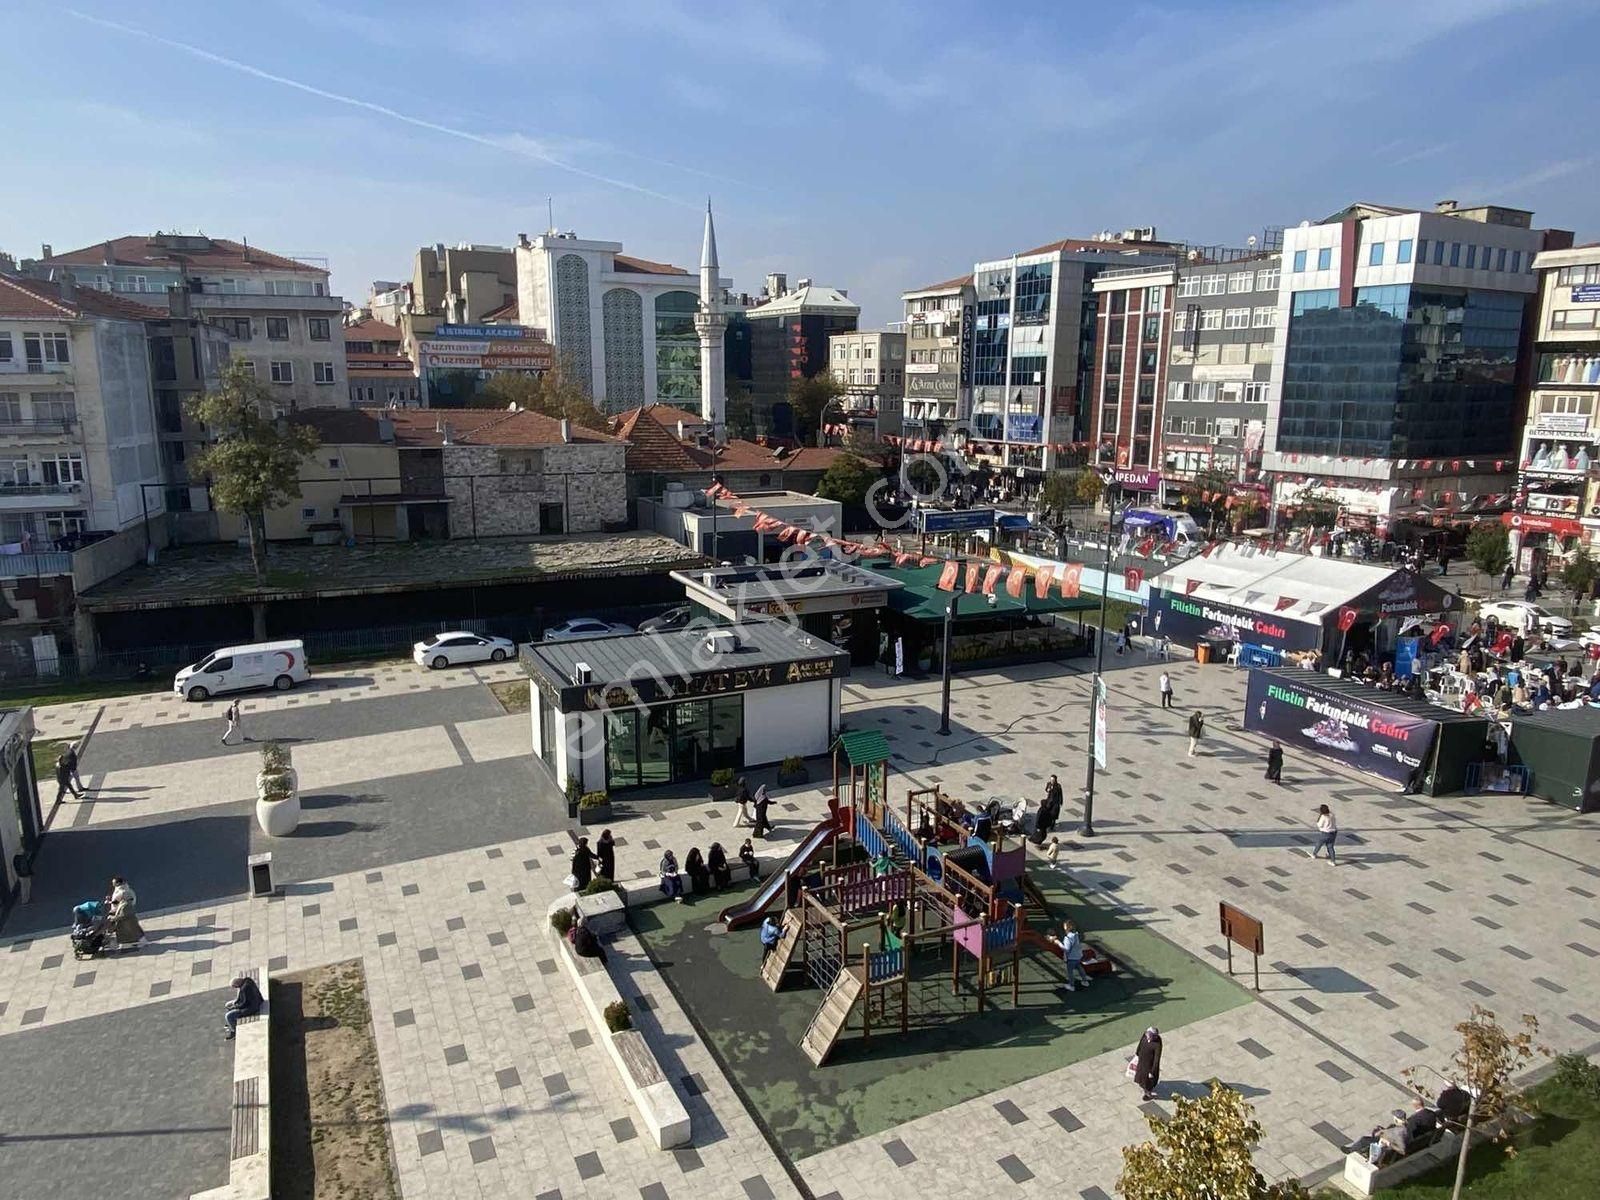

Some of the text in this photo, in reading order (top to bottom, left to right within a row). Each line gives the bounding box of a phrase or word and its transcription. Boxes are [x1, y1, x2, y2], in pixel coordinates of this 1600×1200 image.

[1171, 599, 1201, 617] Filistin
[1202, 607, 1255, 631] Farkındalık
[1256, 621, 1285, 639] Çadırı
[1267, 685, 1409, 741] Filistin Farkındalık Çadırı
